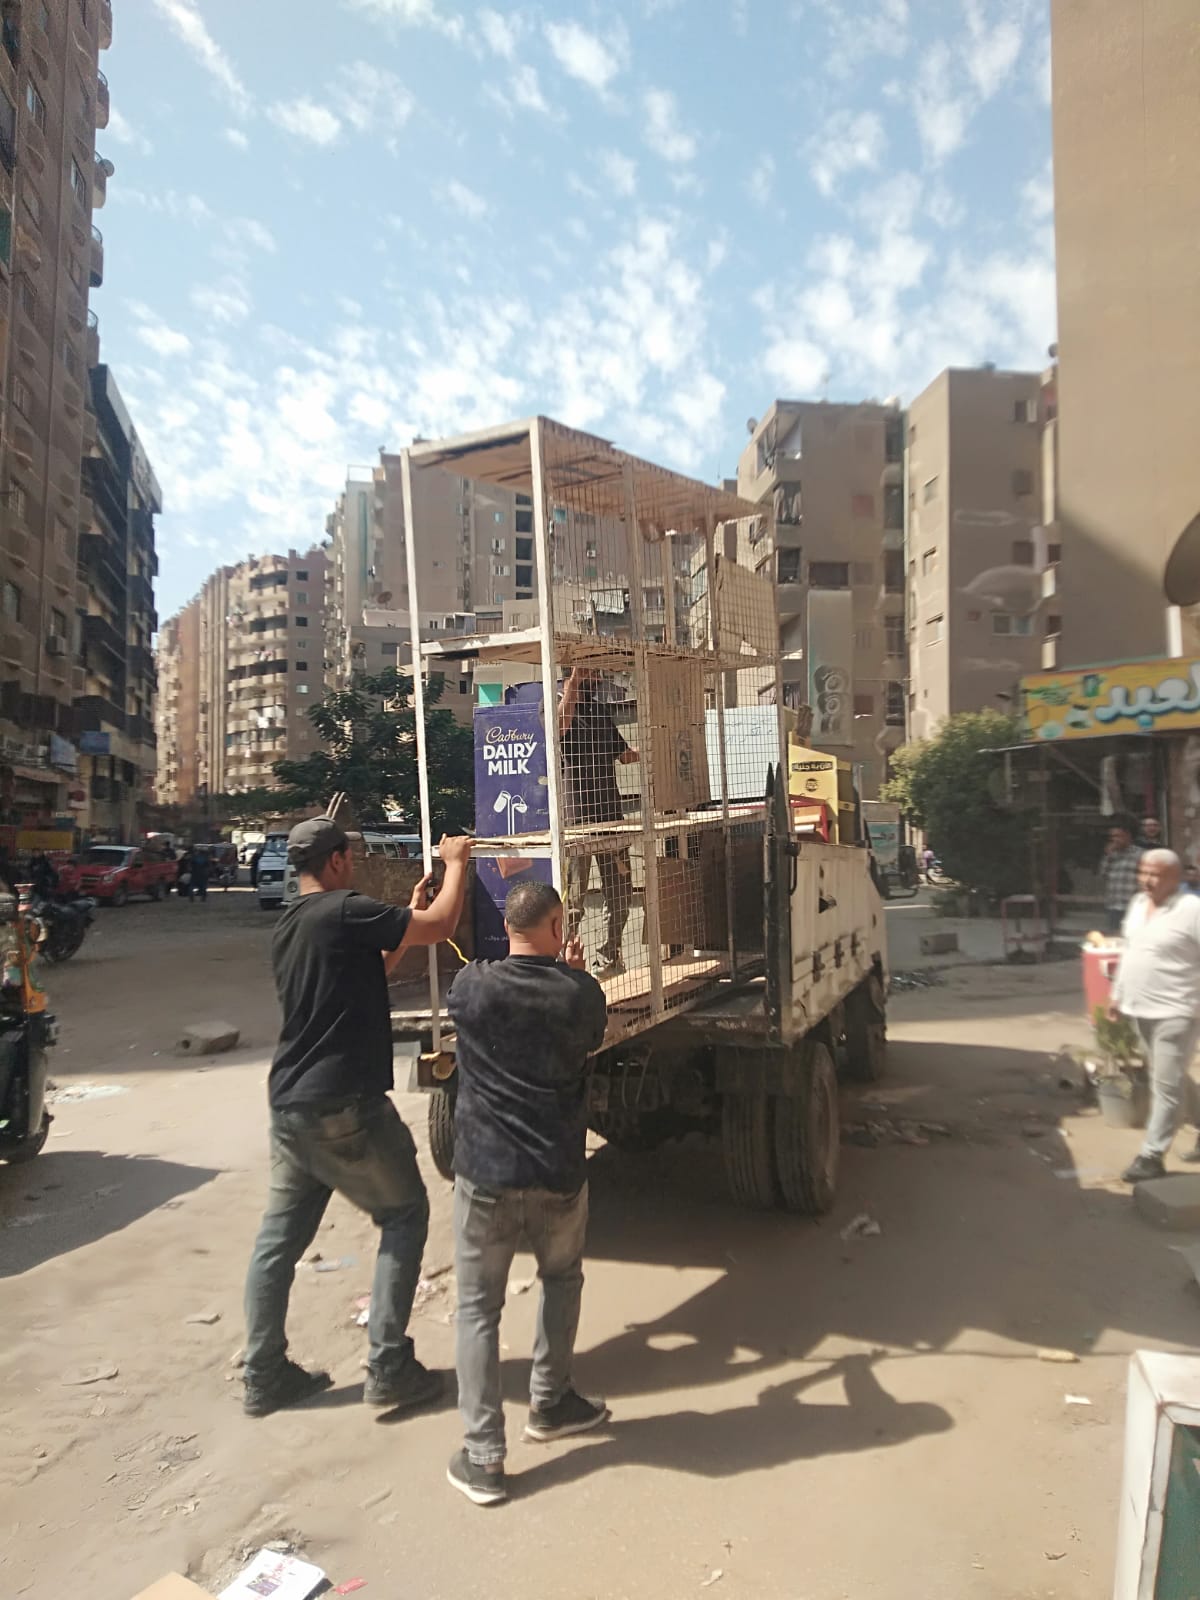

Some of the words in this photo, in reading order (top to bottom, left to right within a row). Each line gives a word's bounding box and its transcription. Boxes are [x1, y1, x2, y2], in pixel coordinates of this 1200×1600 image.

[485, 726, 535, 744] Cadbury
[483, 742, 537, 760] DAIRY
[488, 758, 531, 776] MILK
